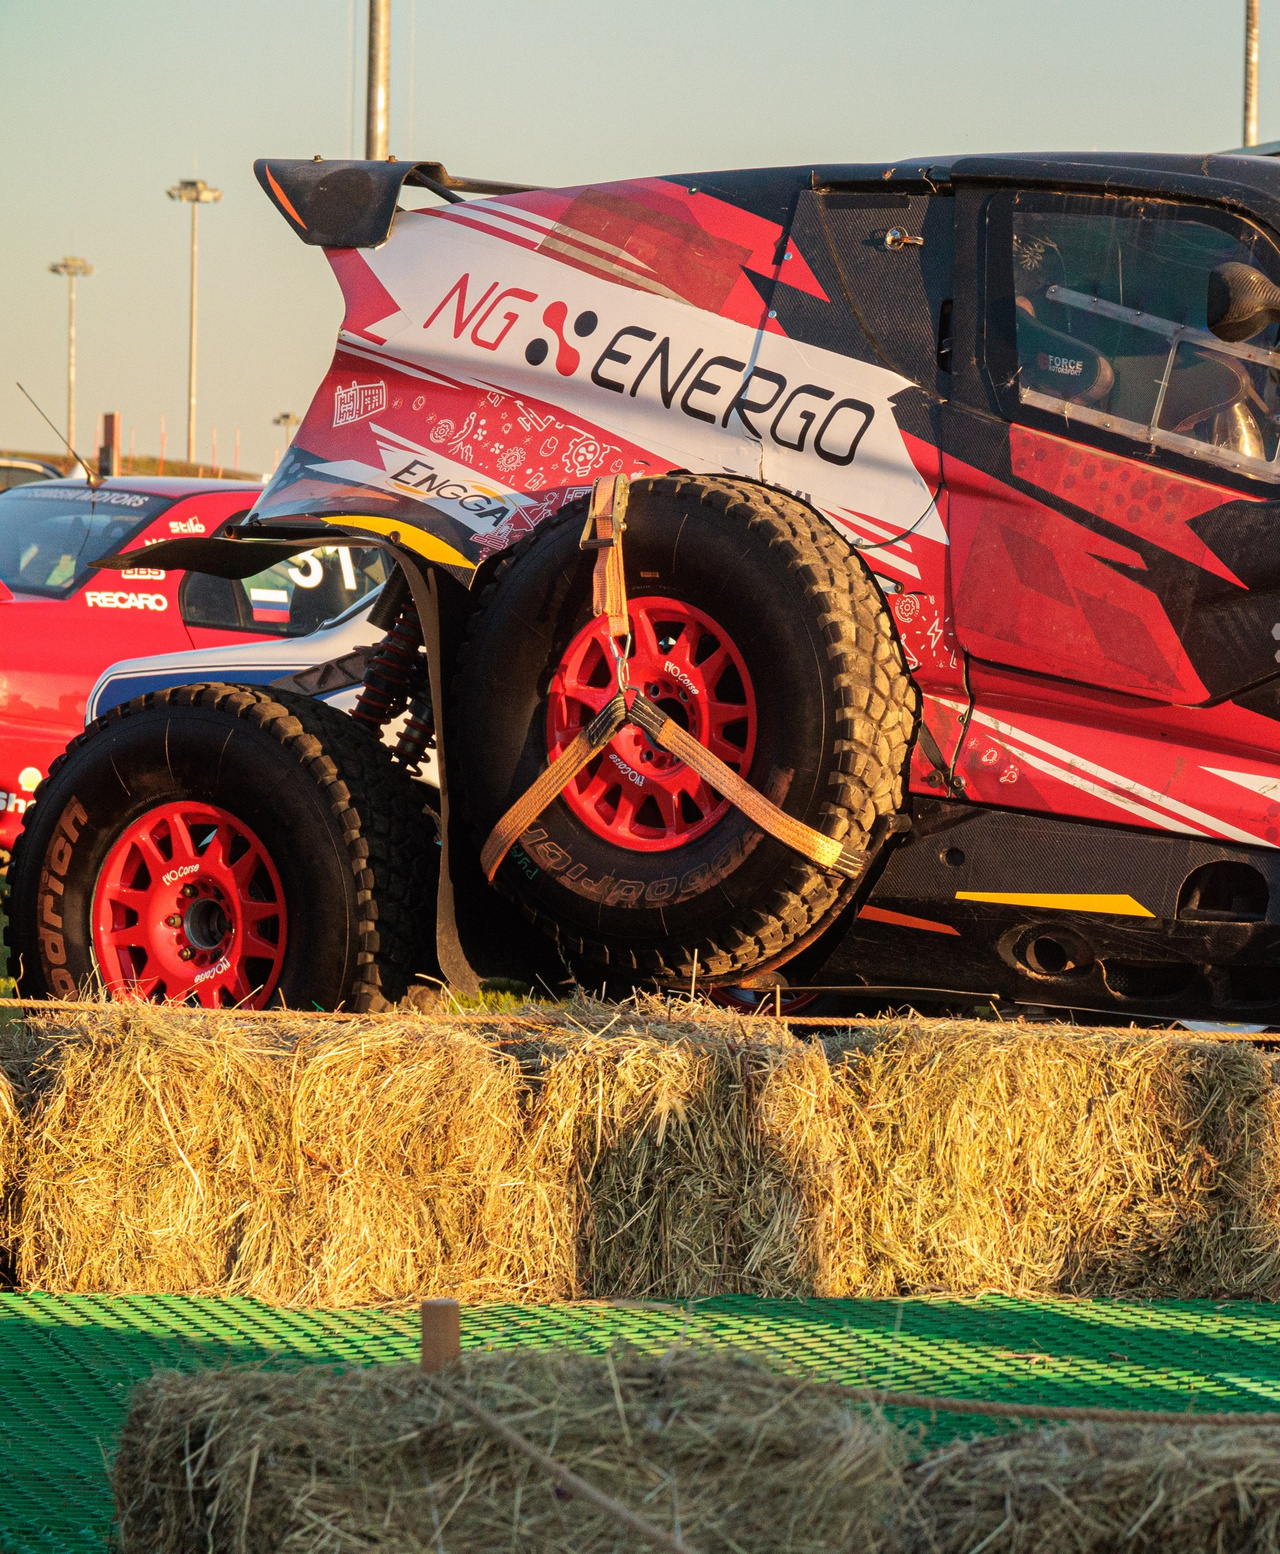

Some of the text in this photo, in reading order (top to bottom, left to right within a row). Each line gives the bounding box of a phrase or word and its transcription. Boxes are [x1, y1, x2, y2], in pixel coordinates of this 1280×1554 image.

[423, 273, 875, 466] NG ENERGO
[169, 516, 205, 534] Stilo
[389, 459, 510, 528] ENGGA
[85, 591, 168, 611] RECARO
[40, 795, 89, 1001] odrich
